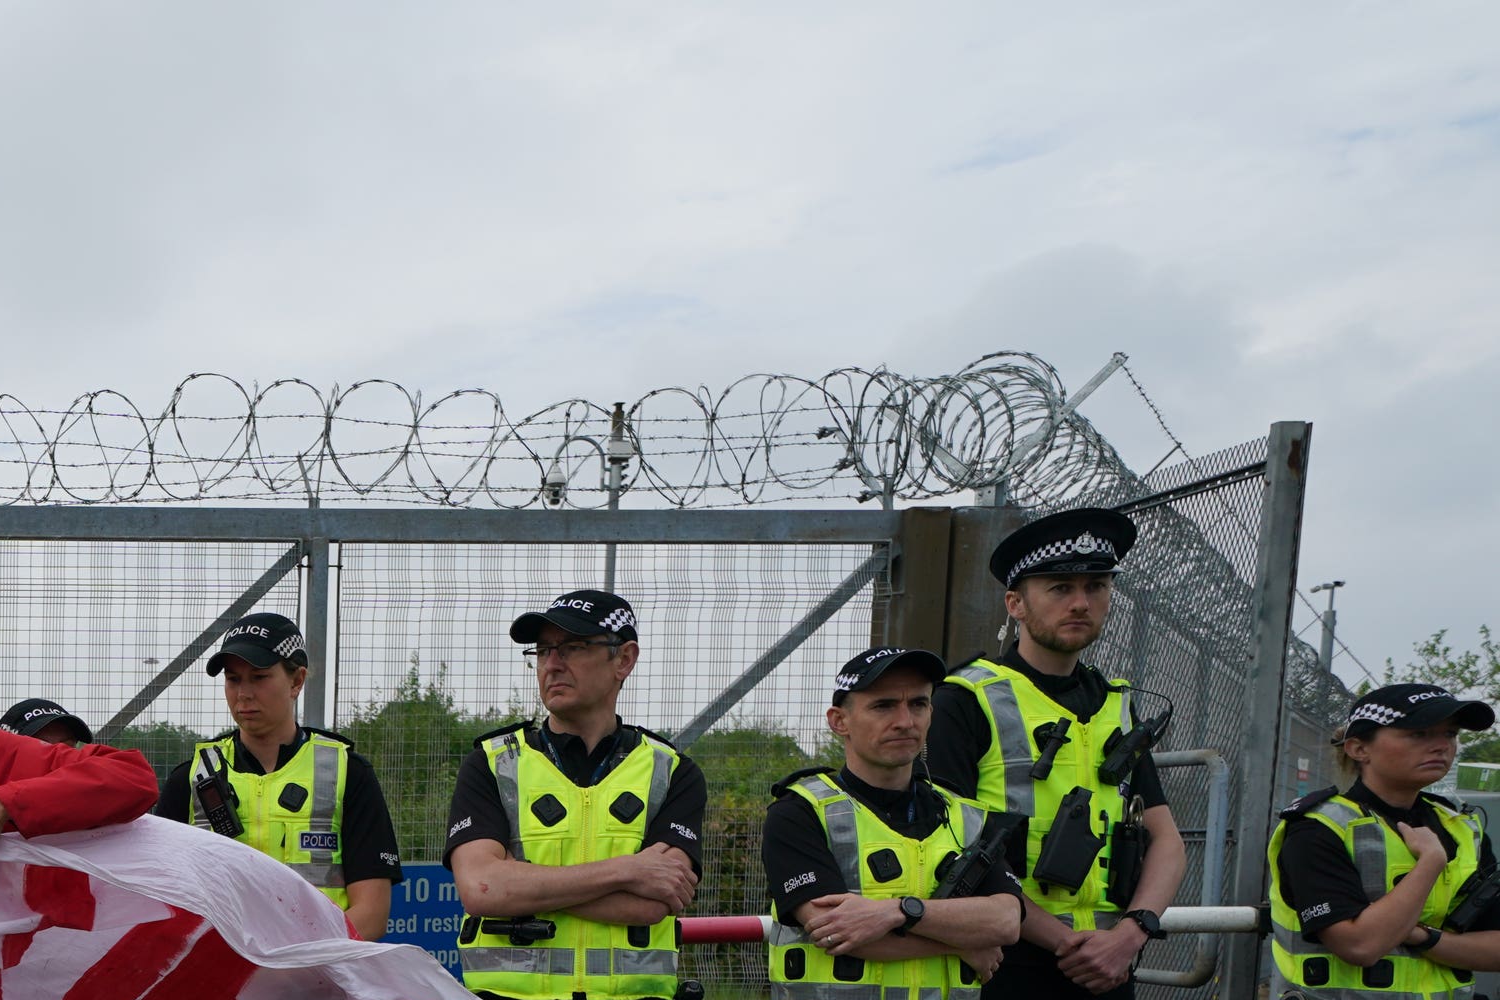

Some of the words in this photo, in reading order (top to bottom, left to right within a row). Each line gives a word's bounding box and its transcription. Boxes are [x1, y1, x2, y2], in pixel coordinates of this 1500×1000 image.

[225, 625, 270, 642] POLICE
[866, 648, 906, 664] POLI
[24, 708, 66, 721] POLIC
[302, 835, 336, 847] POLICE
[784, 871, 815, 889] POLICE
[401, 877, 429, 902] 10
[386, 914, 417, 934] eed
[424, 914, 462, 933] rest
